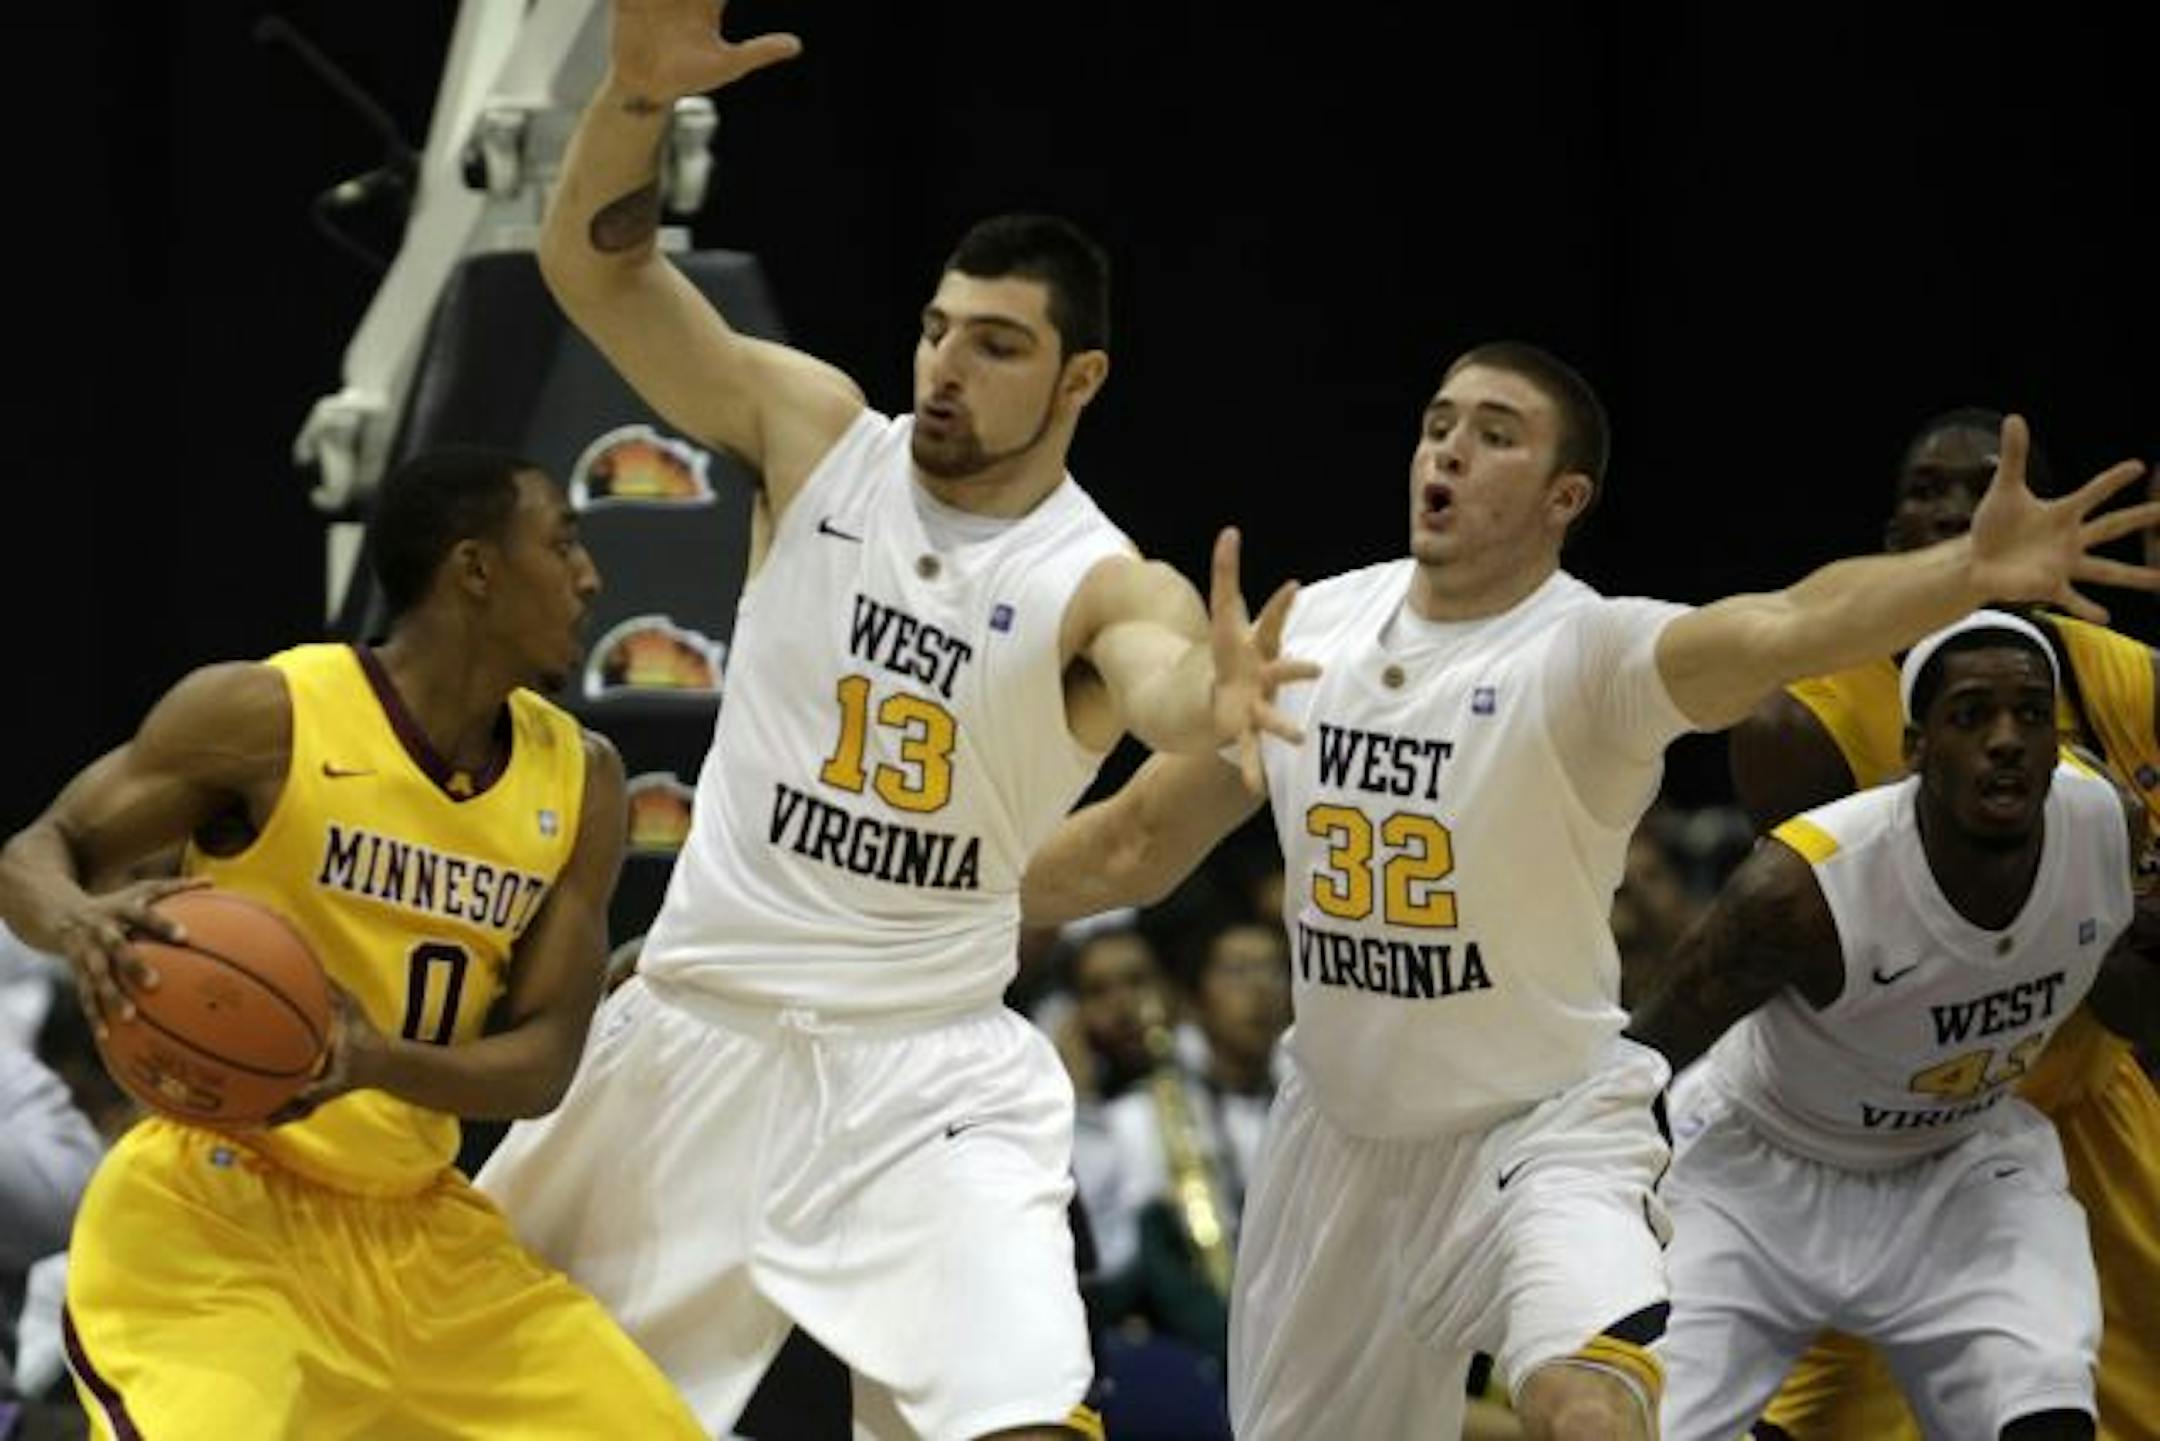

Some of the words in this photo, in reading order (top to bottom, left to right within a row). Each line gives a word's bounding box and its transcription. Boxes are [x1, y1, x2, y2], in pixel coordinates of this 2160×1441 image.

[849, 593, 972, 699] WEST
[819, 673, 958, 814] 13
[1318, 722, 1454, 800] WEST
[317, 825, 546, 934] MINNESOT
[767, 782, 982, 890] VIRGINIA
[1305, 803, 1458, 929] 32
[402, 940, 470, 1046] 0
[1299, 921, 1493, 1000] VIRGINIA
[1930, 971, 2065, 1046] WEST
